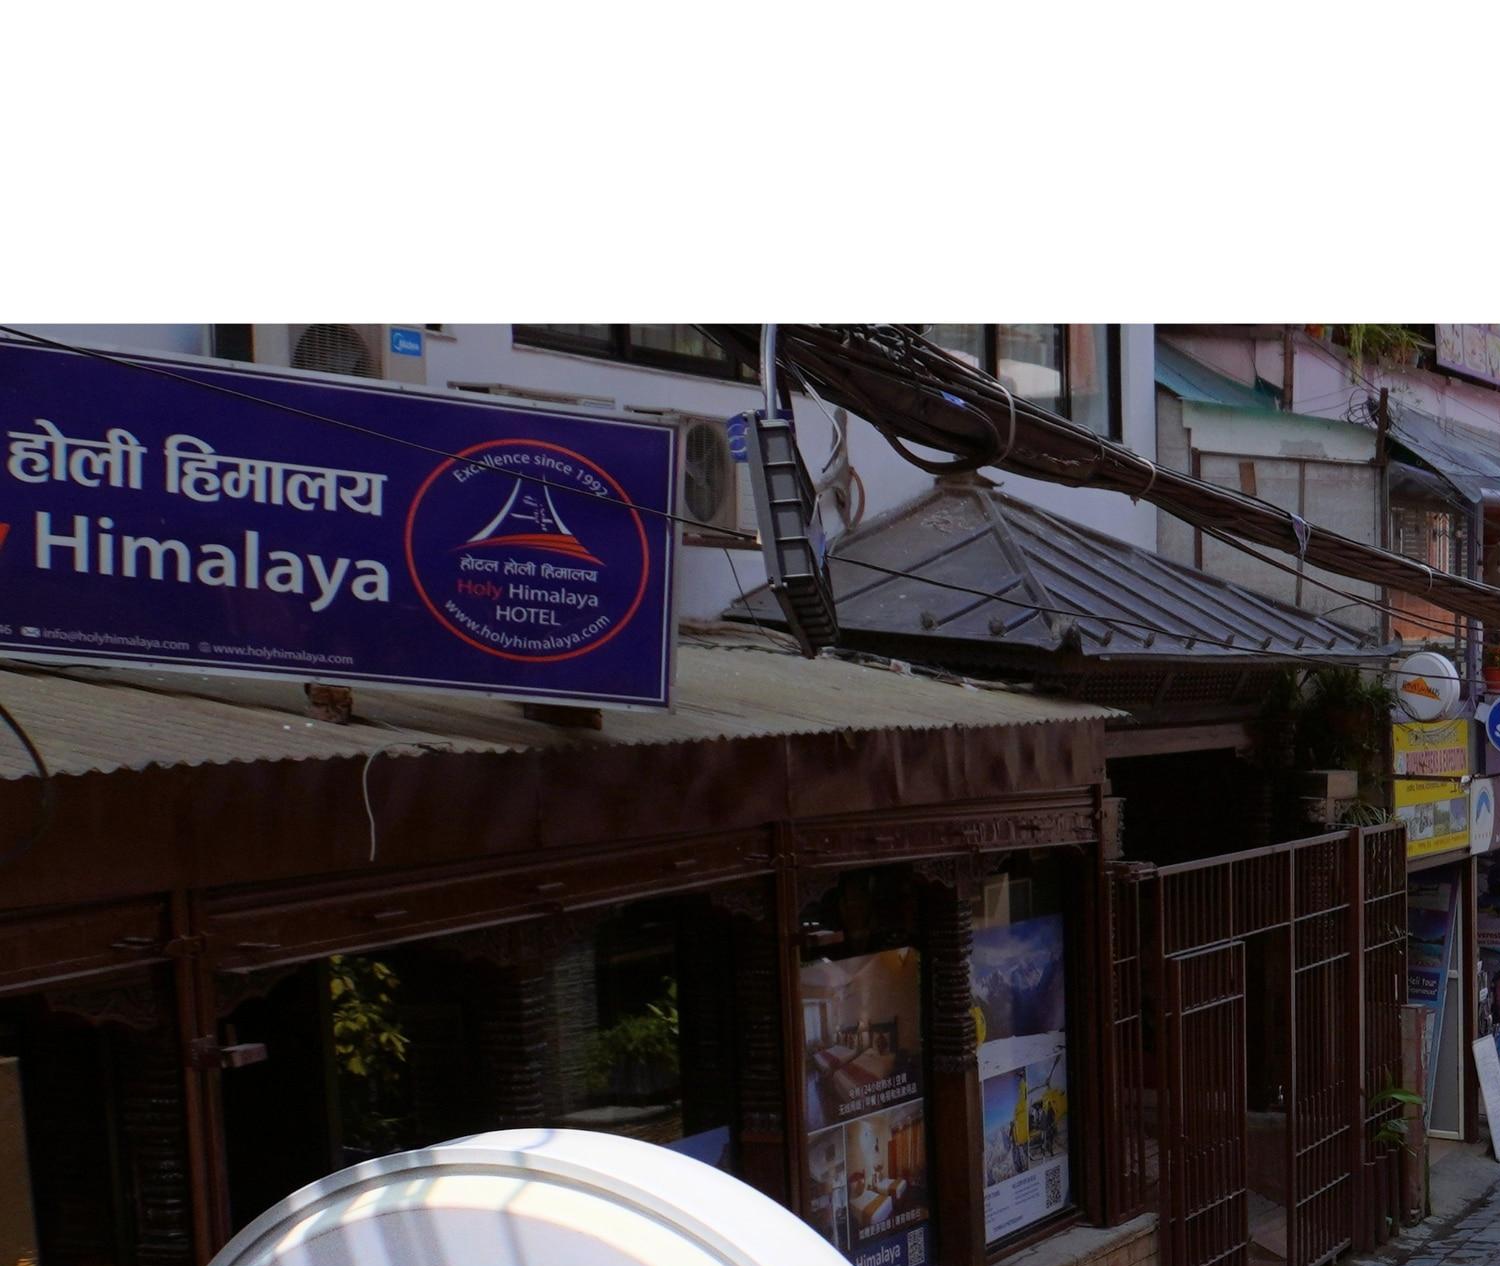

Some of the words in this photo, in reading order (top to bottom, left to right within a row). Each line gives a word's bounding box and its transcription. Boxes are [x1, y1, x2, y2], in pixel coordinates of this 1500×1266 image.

[7, 418, 148, 490] होली
[164, 433, 389, 517] हिमालय
[452, 453, 531, 484] Excellence
[534, 453, 573, 476] since
[575, 469, 609, 498] 1992
[36, 510, 390, 613] Himalaya
[460, 553, 499, 573] होटल
[504, 558, 536, 577] होली
[541, 563, 598, 583] हिमालय
[457, 578, 502, 600] Holy
[508, 583, 599, 610] Himalaya
[444, 599, 611, 650] www.holyhimalaya.com
[495, 605, 561, 626] HOTEL
[43, 627, 190, 652] info@holyhimalaya.com
[213, 642, 354, 665] www.holyhimalaya.com
